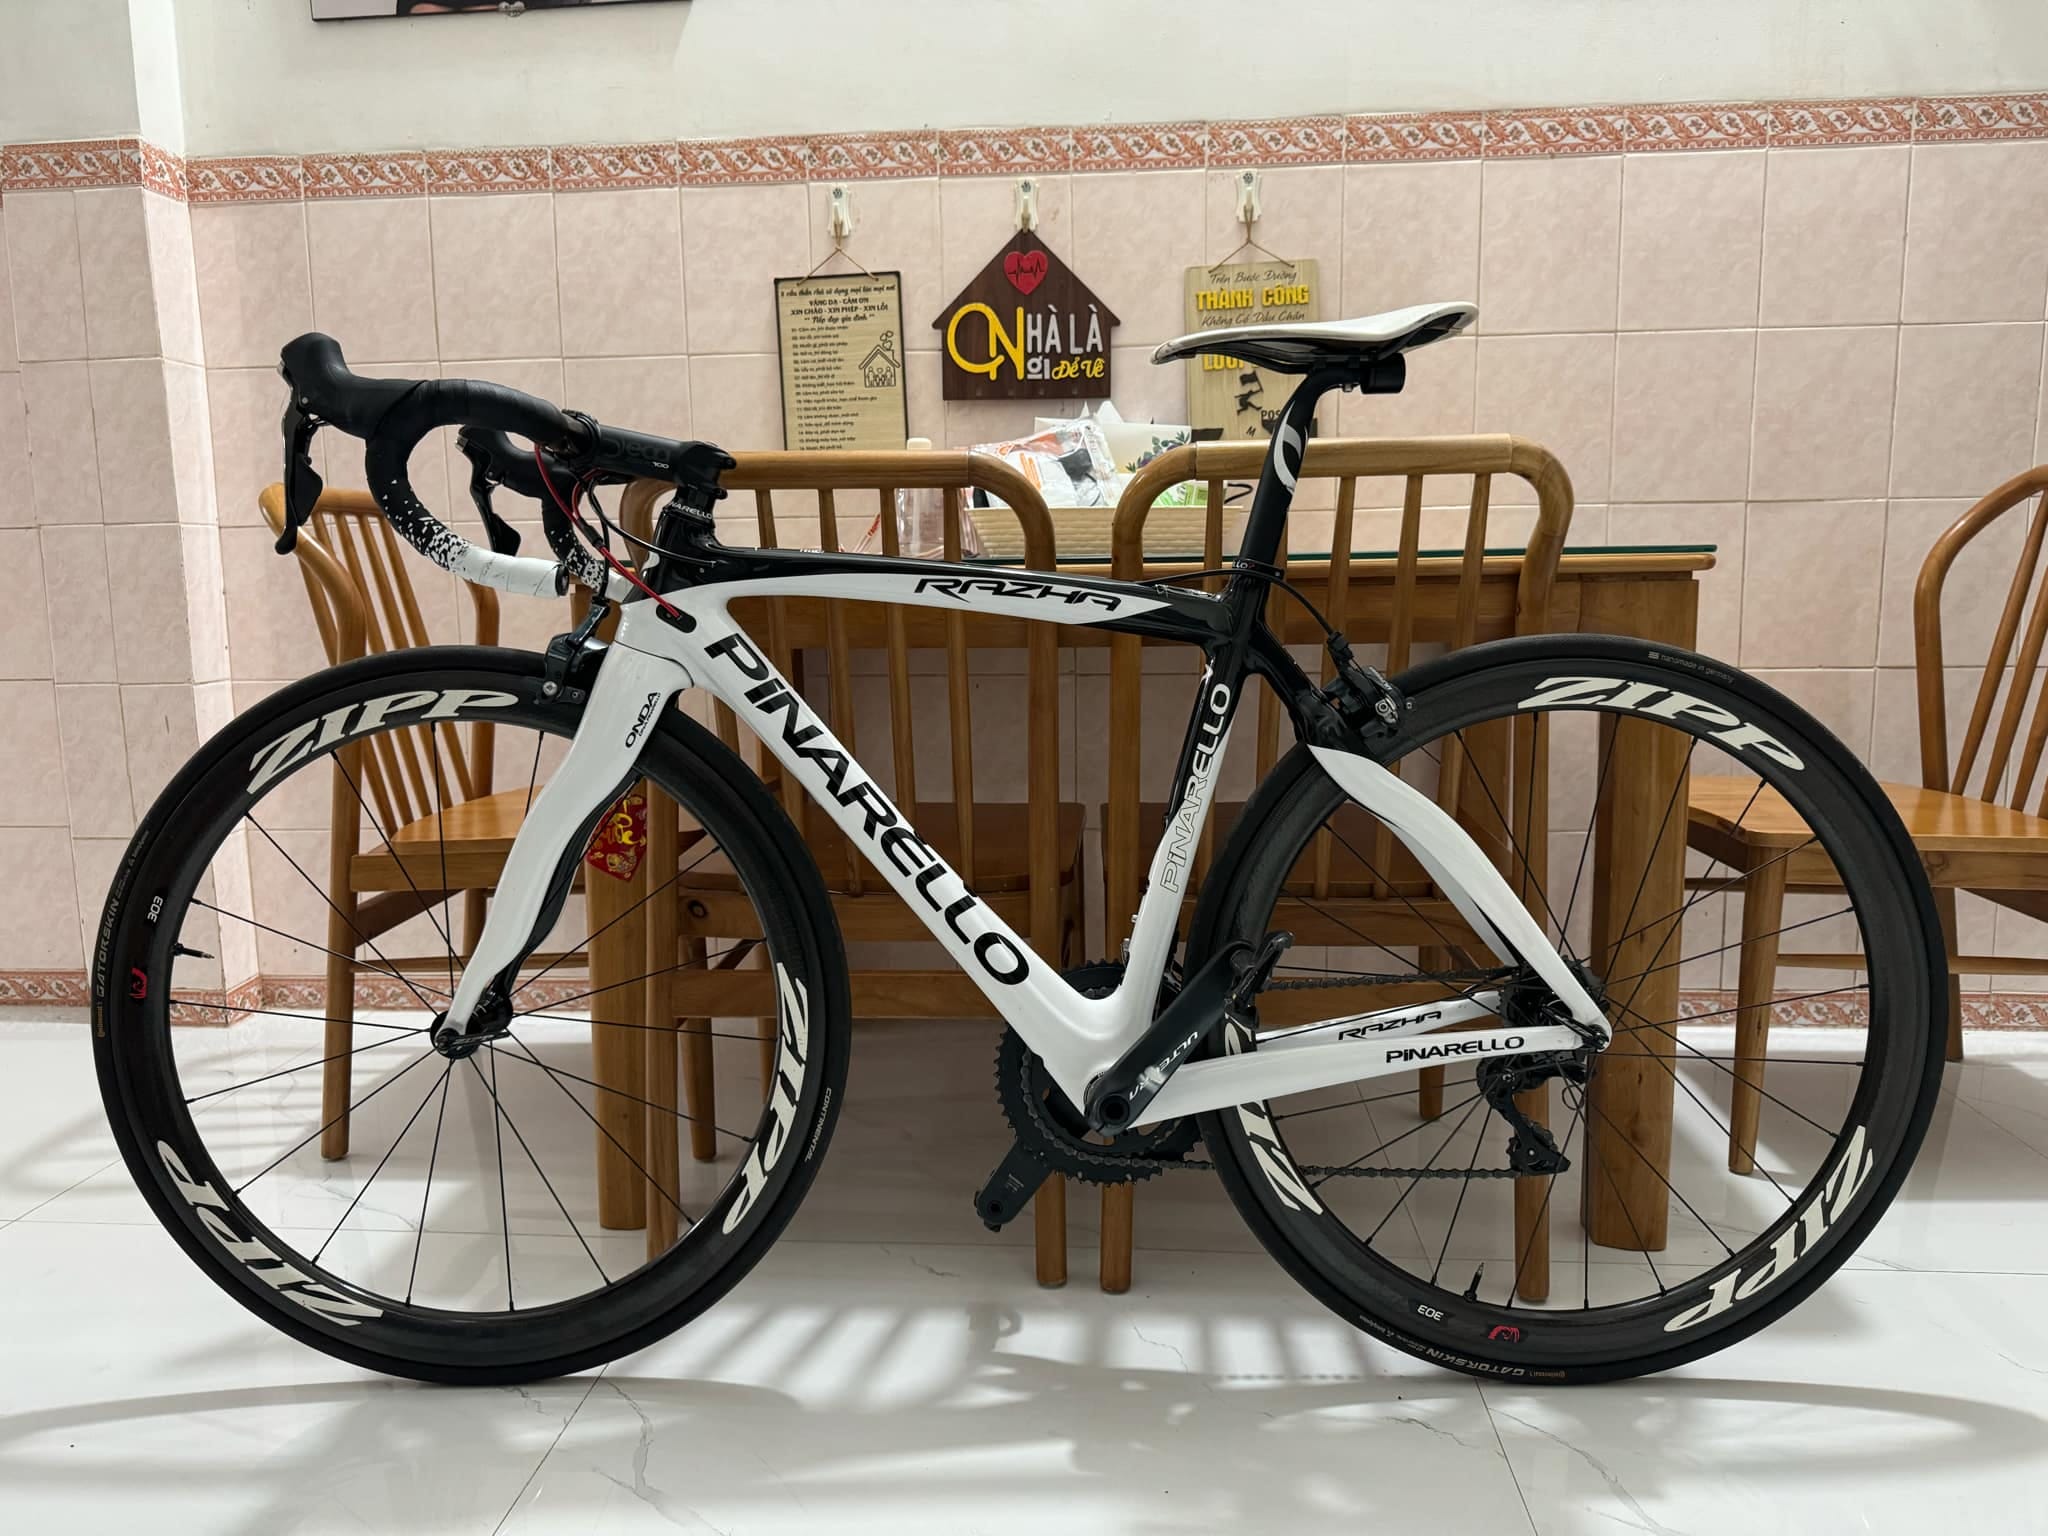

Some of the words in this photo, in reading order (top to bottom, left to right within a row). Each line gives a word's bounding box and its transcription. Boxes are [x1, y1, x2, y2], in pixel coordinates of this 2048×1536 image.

[1196, 287, 1254, 311] THÀNH
[1262, 283, 1310, 307] CÔNG
[1069, 304, 1103, 354] LÀ
[914, 577, 1121, 611] RAZHA
[246, 689, 519, 795] ZIPP
[625, 692, 658, 748] ONDA
[1518, 676, 1805, 771] ZIPP
[147, 895, 163, 923] 303
[97, 898, 120, 998] GATORSKIN
[1338, 1010, 1442, 1041] RAZHA
[722, 961, 809, 1235] ZIPP
[157, 1139, 384, 1326] ZIPP
[1663, 1125, 1873, 1332] ZIPP
[1417, 1304, 1444, 1321] 303
[1426, 1348, 1525, 1376] GATORSKIN
